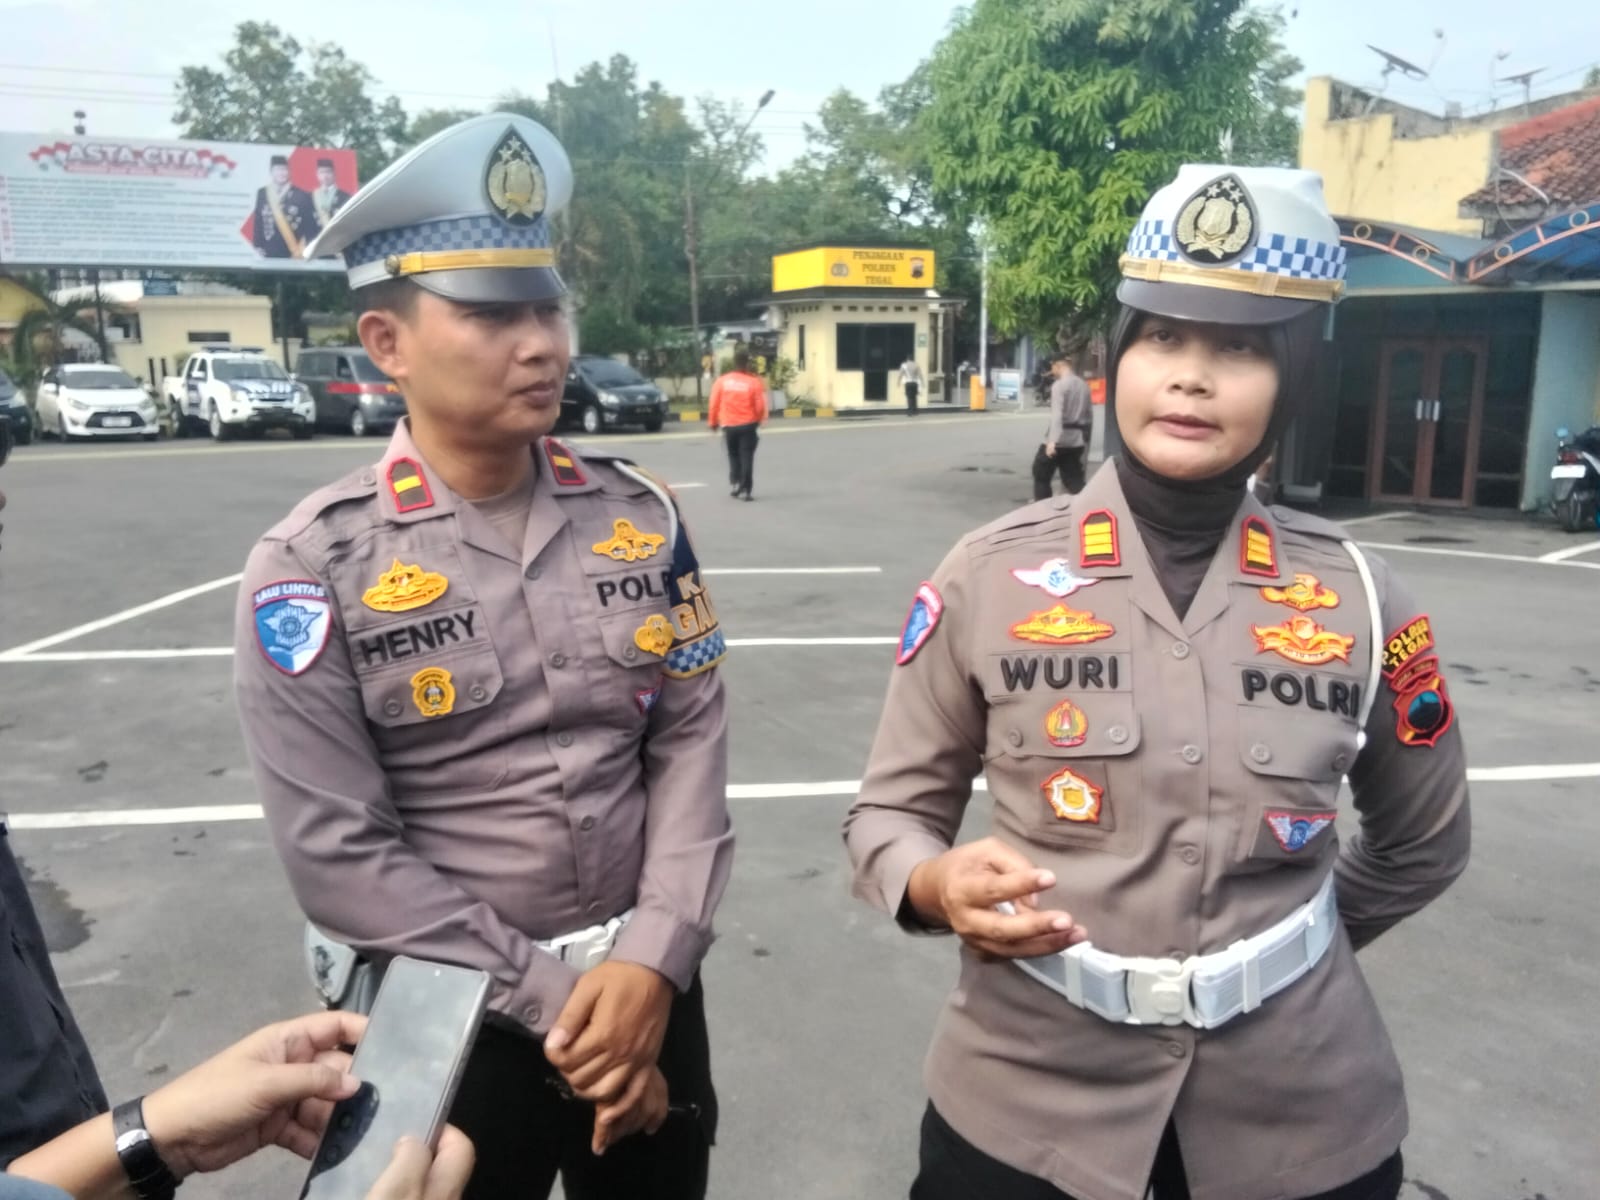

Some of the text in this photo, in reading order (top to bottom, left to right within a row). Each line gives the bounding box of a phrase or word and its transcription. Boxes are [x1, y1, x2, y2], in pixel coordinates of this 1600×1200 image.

[66, 144, 201, 167] ASTA CITA
[255, 583, 325, 603] LALU LINTAS
[359, 610, 475, 666] HENRY
[1000, 655, 1119, 692] WURI
[1241, 668, 1361, 719] POLRI
